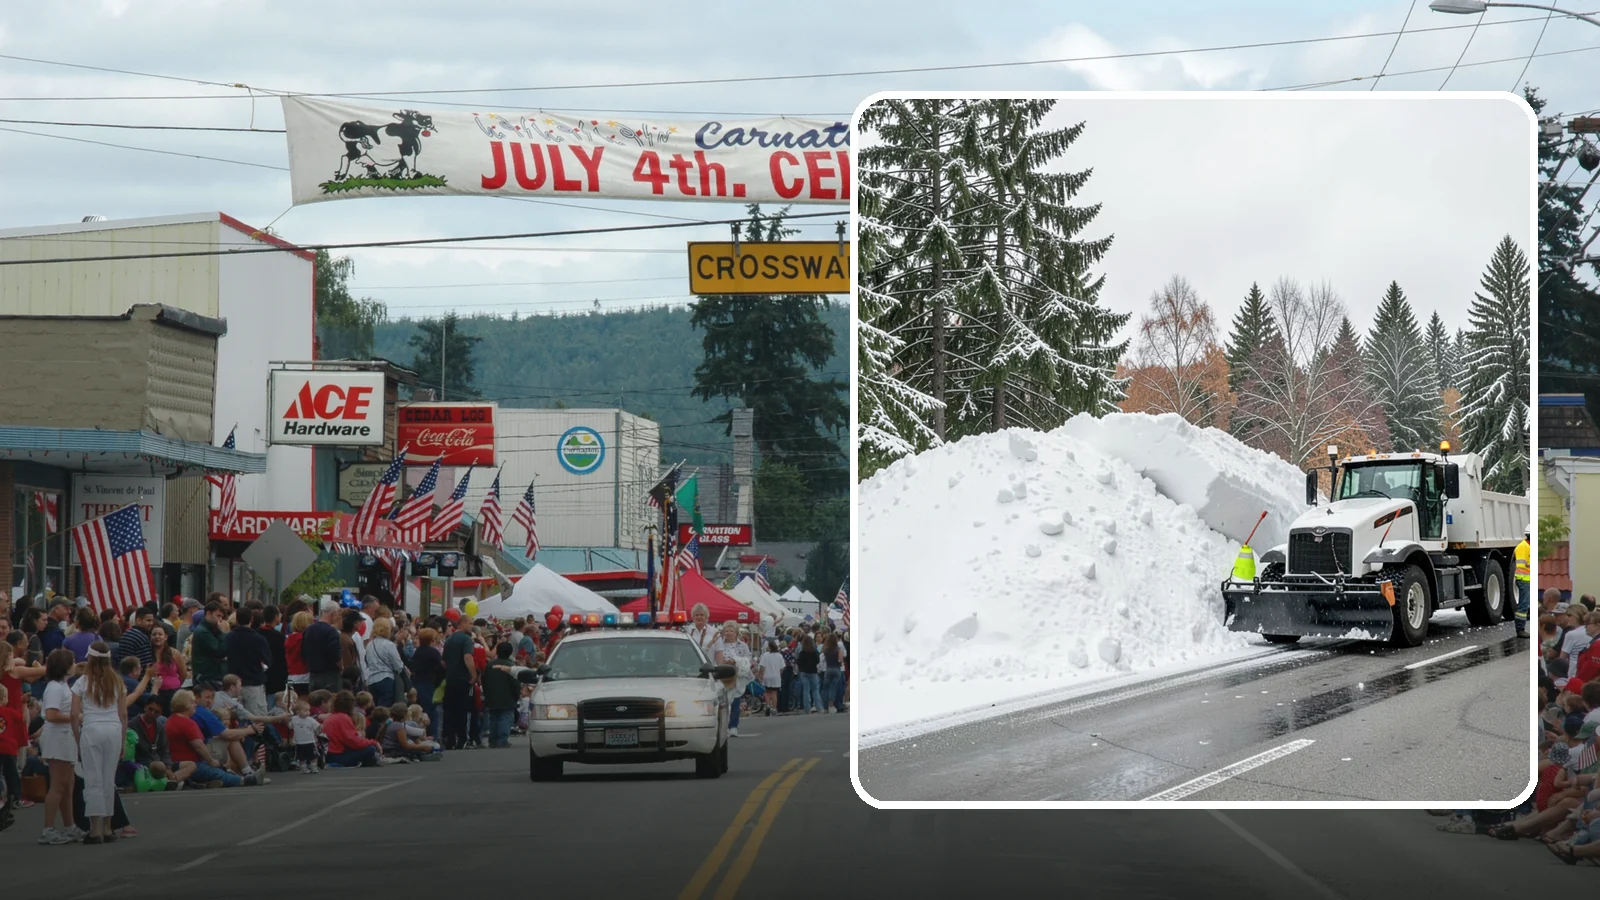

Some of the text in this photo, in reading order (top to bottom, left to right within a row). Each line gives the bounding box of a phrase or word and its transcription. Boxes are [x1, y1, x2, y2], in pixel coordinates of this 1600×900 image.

[481, 141, 605, 192] JULY
[632, 150, 746, 197] 4th.
[697, 254, 850, 279] CROSSWA
[282, 380, 374, 420] ACE
[405, 409, 485, 422] CEDAR LOG
[283, 421, 371, 436] Hardware
[416, 428, 477, 447] Coca-Cola
[353, 467, 387, 479] Simpl
[95, 485, 124, 494] Vincent
[126, 486, 136, 494] de
[137, 486, 155, 495] Paul
[688, 526, 741, 535] CRNATION
[699, 535, 730, 543] GLASS
